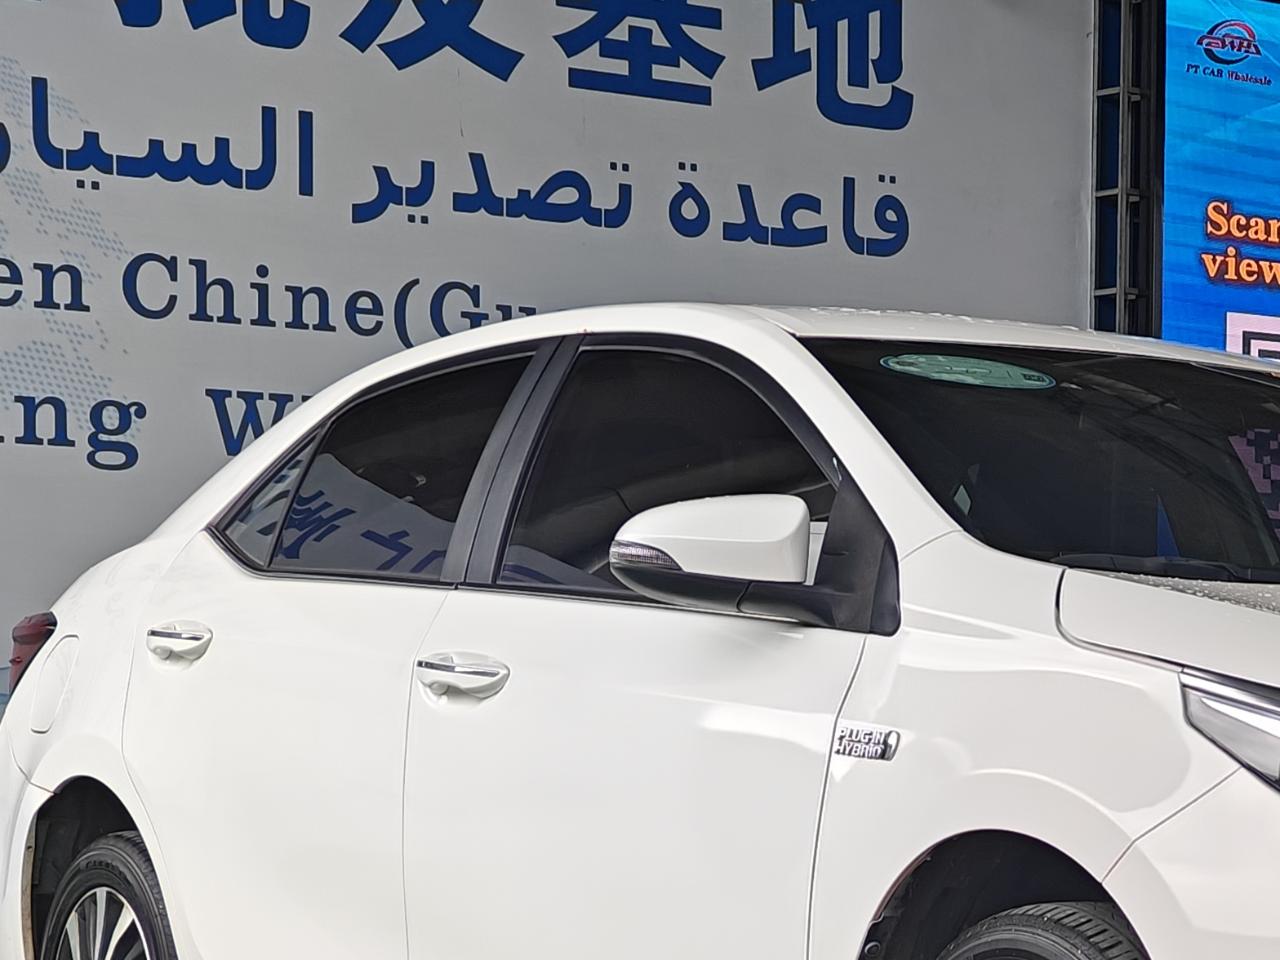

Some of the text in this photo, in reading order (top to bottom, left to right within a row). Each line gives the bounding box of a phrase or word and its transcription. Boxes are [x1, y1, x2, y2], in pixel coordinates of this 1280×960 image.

[352, 151, 633, 229] تصدير
[669, 161, 909, 257] قاعدة
[0, 257, 91, 312] en
